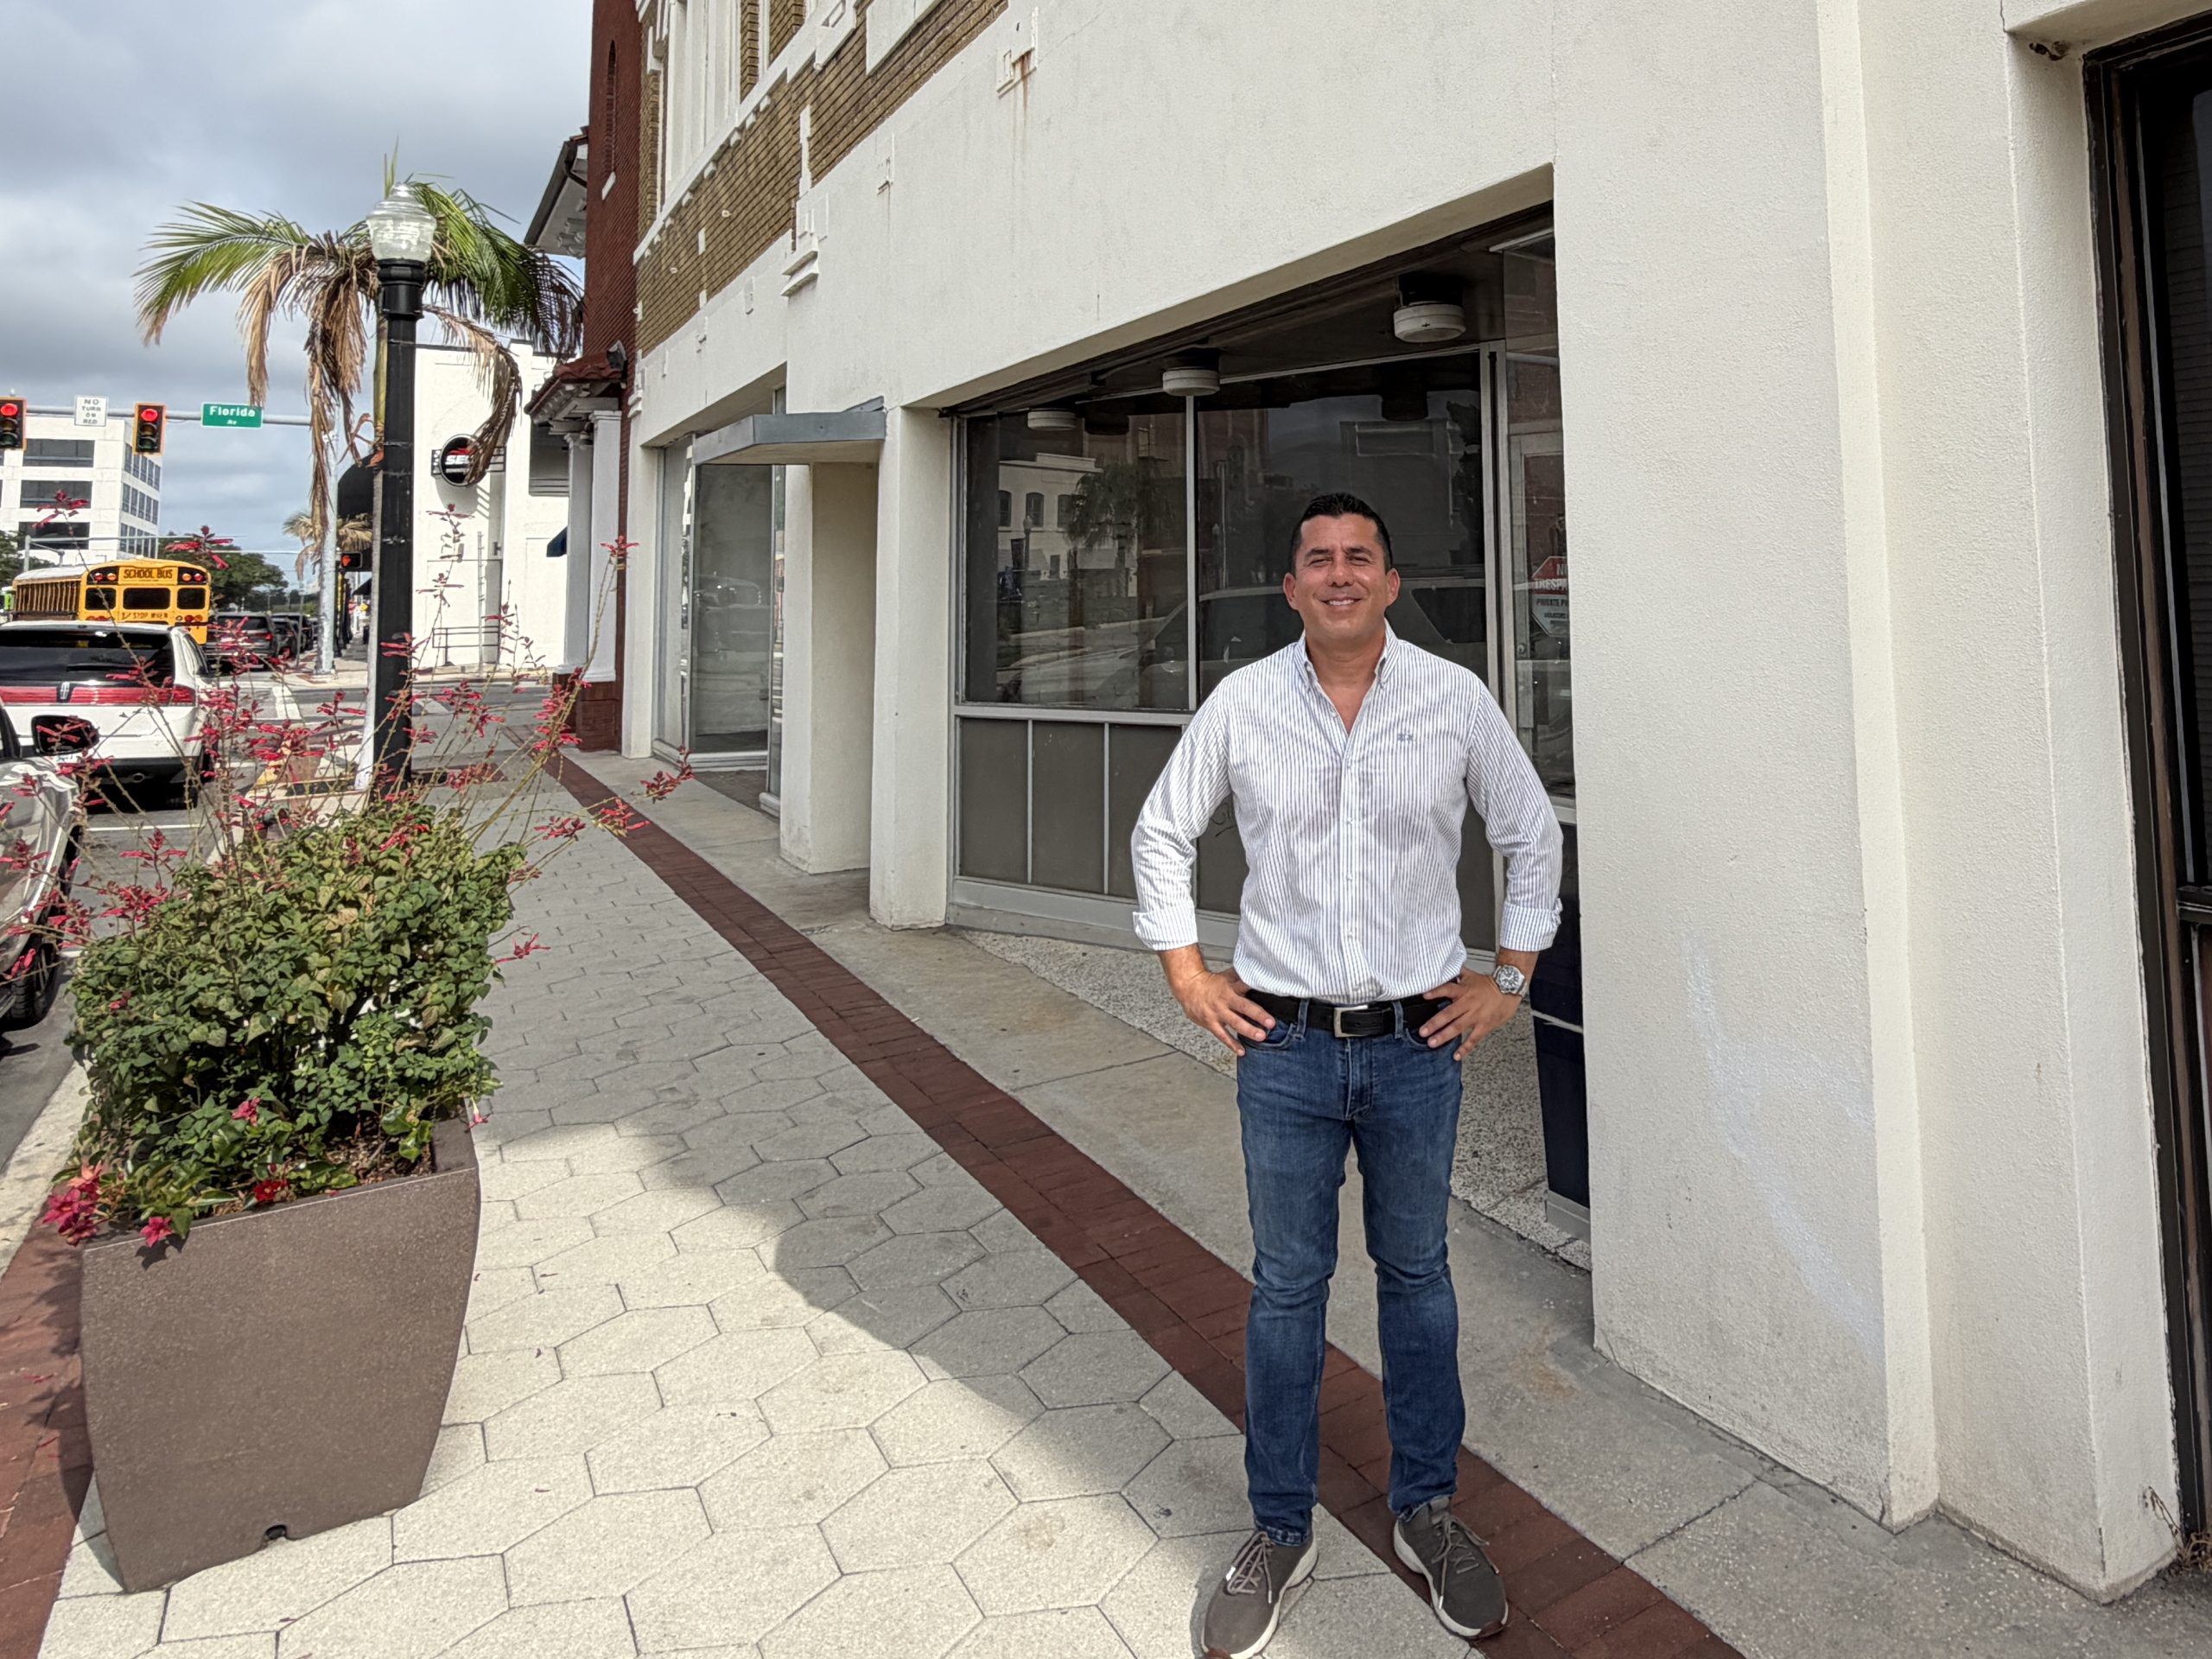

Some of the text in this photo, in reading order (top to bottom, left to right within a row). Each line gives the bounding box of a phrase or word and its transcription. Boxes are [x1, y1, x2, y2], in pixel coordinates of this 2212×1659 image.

[209, 405, 256, 417] Florida
[124, 569, 173, 579] SCHOOL BUS
